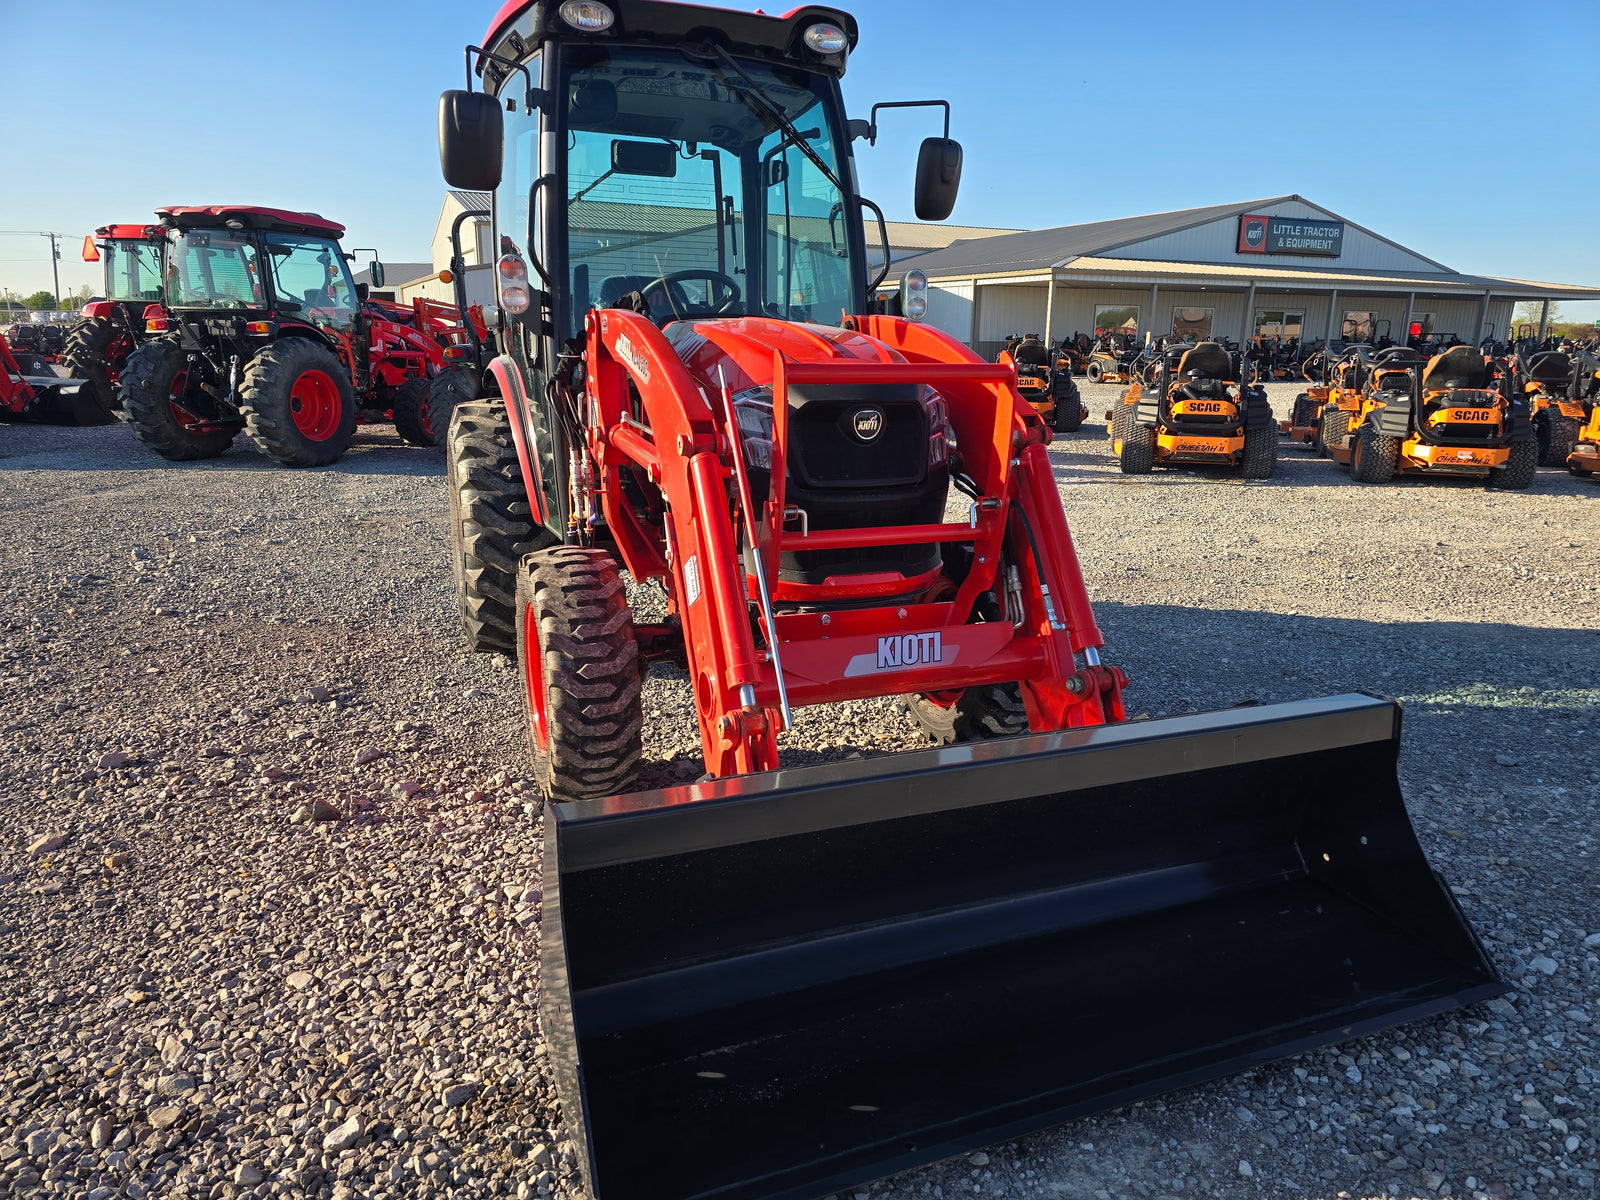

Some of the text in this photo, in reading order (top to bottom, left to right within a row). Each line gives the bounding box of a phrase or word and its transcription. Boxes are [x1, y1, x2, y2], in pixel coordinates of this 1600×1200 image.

[1273, 225, 1340, 238] LITTLE TRACTOR
[1278, 238, 1333, 249] & EQUIPMENT
[1189, 403, 1221, 412] SCAG
[1454, 411, 1490, 421] SCAG
[858, 420, 878, 430] KIOTI
[1176, 444, 1218, 452] CHEETAH
[877, 631, 942, 668] KIOTI
